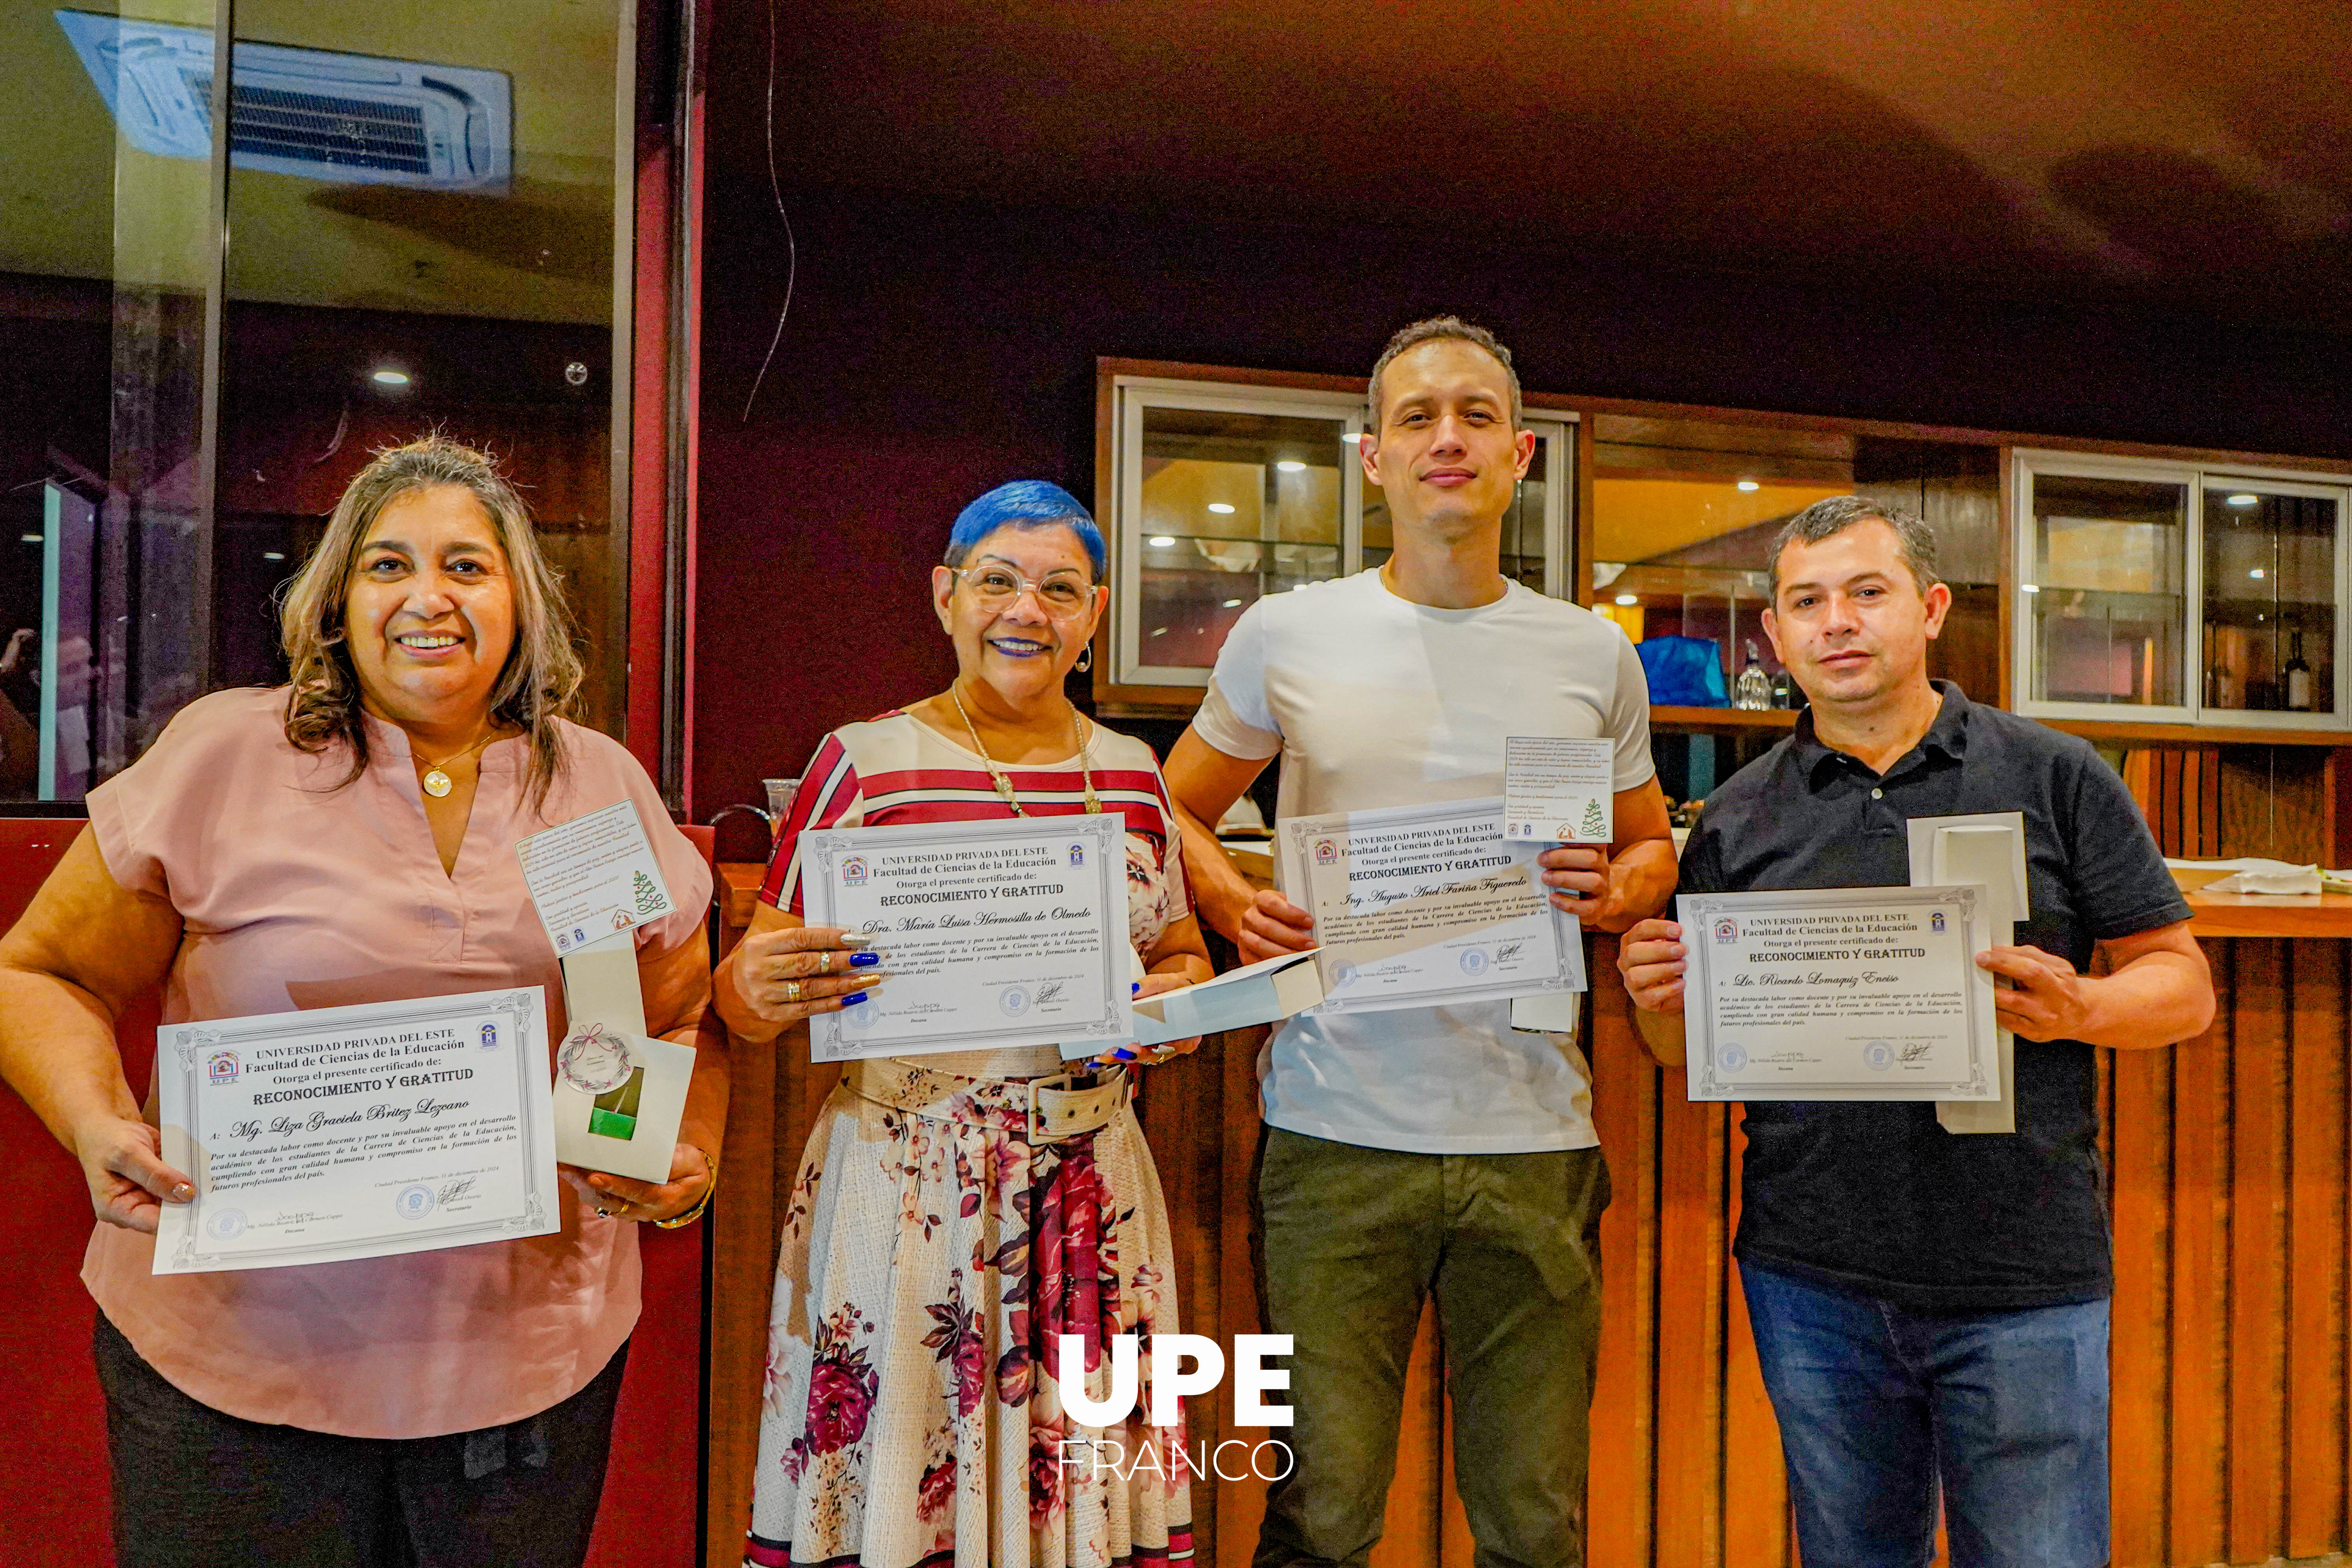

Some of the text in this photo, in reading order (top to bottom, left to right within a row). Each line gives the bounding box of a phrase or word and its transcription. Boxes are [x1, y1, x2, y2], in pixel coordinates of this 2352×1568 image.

[1341, 846, 1379, 857] Facultad
[1394, 841, 1431, 851] Ciencias
[1457, 832, 1503, 844] Educación
[1348, 824, 1495, 846] UNIVERSIDAD PRIVADA DEL ESTE
[873, 857, 1056, 877] Facultad de Ciencias de la Educación
[882, 847, 1048, 865] UNIVERSIDAD PRIVADA DEL ESTE
[1349, 855, 1512, 881] RECONOCIMIENTO Y GRATITUD
[1399, 853, 1430, 864] presente
[1432, 848, 1473, 858] certificado
[897, 881, 927, 889] Otorga
[939, 877, 975, 888] presente
[977, 873, 1022, 883] certificado
[1340, 893, 1364, 908] Ing.
[1368, 890, 1408, 905] Augusto
[1410, 886, 1441, 898] Ariel
[1441, 882, 1478, 895] Fariña
[1479, 876, 1526, 894] Figueredo
[880, 884, 1063, 907] RECONOCIMIENTO Y GRATITUD
[862, 907, 1091, 935] Dra. María Luisa Hermosilla de Olmedo
[1742, 927, 1782, 937] Facultad
[1799, 926, 1839, 935] Ciencias
[1867, 923, 1917, 932] Educación
[1750, 917, 1816, 926] UNIVERSIDAD
[1804, 939, 1837, 948] presente
[1839, 936, 1883, 945] certificado
[1749, 948, 1926, 963] RECONOCIMIENTO Y GRATITUD
[1733, 974, 1755, 987] Lic.
[1759, 973, 1804, 985] Ricardo
[1806, 972, 1859, 988] Lomaquiz
[1861, 971, 1899, 984] Enciso
[257, 1029, 455, 1059] UNIVERSIDAD PRIVADA DEL ESTE
[246, 1040, 464, 1073] Facultad de Ciencias de la Educación
[273, 1058, 441, 1084] Otorga el presente certificado de:
[253, 1069, 473, 1105] RECONOCIMIENTO Y GRATITUD
[229, 1120, 262, 1142] Mg.
[268, 1116, 304, 1138] Liza
[306, 1111, 363, 1132] Graciela
[414, 1098, 469, 1118] Lezcano
[240, 1146, 278, 1157] destacada
[326, 1137, 356, 1145] docente
[365, 1134, 378, 1142] por
[392, 1126, 431, 1137] invaluable
[434, 1124, 456, 1132] apoyo
[479, 1114, 516, 1125] desarrollo
[211, 1160, 252, 1171] académico
[289, 1151, 330, 1161] estudiantes
[363, 1142, 393, 1151] Carrera
[412, 1134, 443, 1143] Ciencias
[211, 1169, 256, 1181] cumpliendo
[278, 1165, 297, 1174] gran
[301, 1159, 330, 1169] calidad
[333, 1156, 365, 1165] humana
[377, 1148, 423, 1158] compromiso
[451, 1138, 490, 1150] formación
[211, 1170, 325, 1193] futuros profesionales del país.
